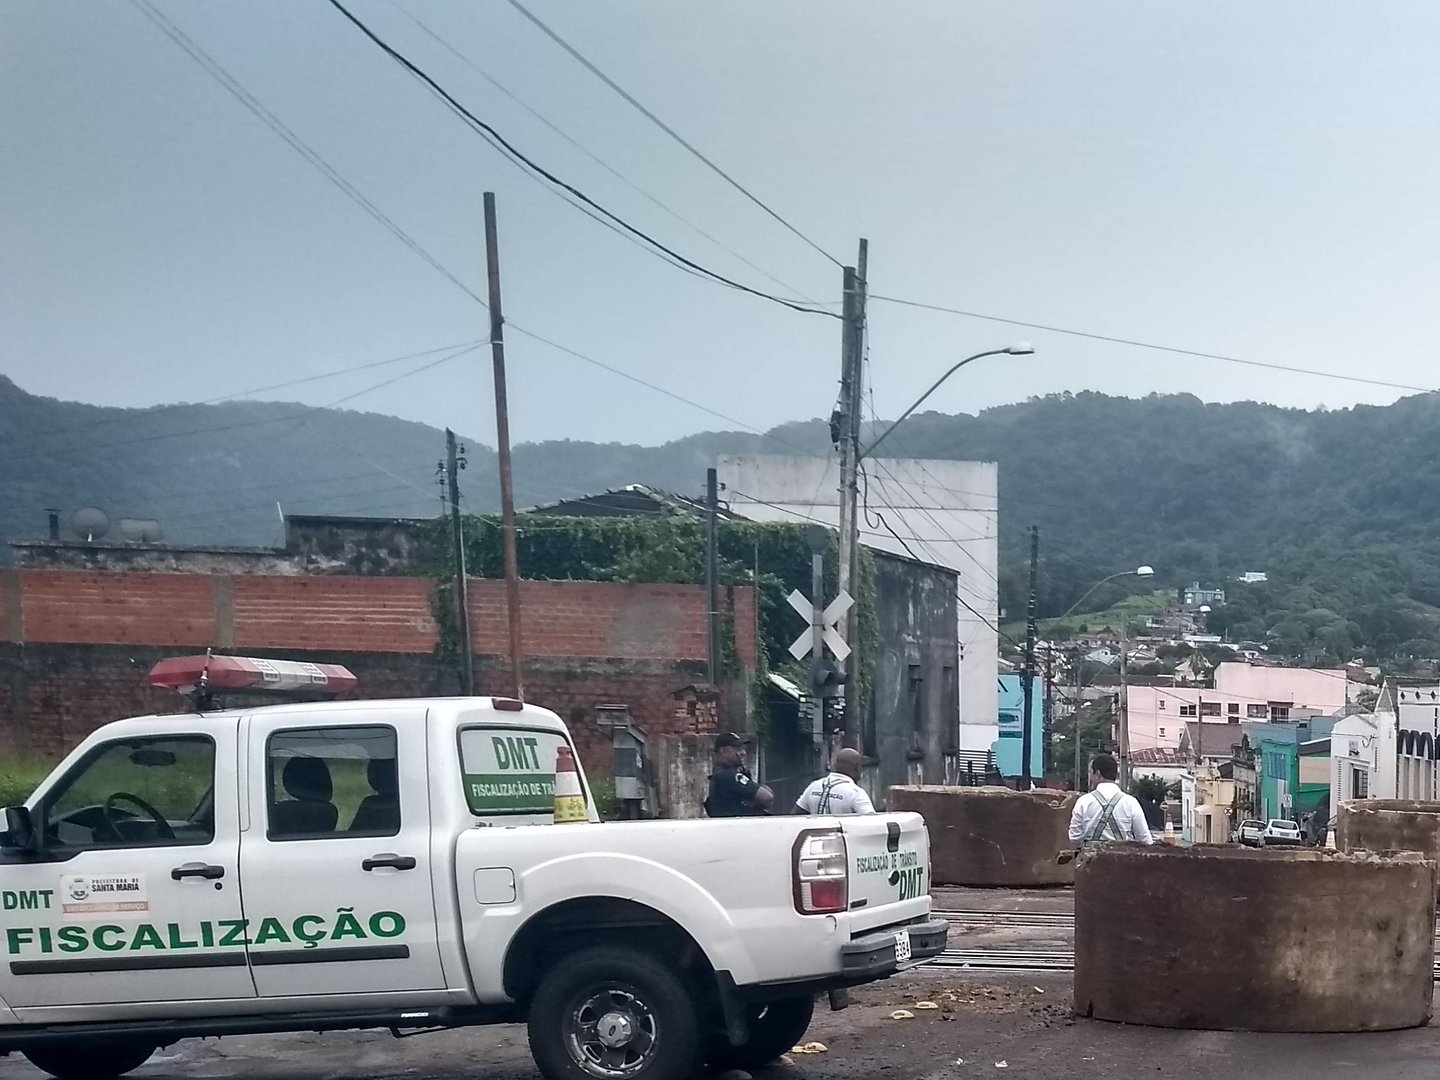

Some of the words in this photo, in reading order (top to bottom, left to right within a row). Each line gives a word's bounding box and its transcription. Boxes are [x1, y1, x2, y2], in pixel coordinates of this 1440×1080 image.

[491, 736, 541, 770] DMT
[471, 781, 530, 799] FISCALIZAÇÃO
[530, 783, 541, 796] DE
[856, 852, 888, 874] FISCALIZAÇÃO
[891, 853, 897, 869] DE
[91, 884, 115, 892] SANTA
[116, 882, 140, 891] MARIA
[899, 867, 923, 901] DMT
[2, 889, 54, 910] DMT
[6, 907, 406, 955] FISCALIZAÇÃO
